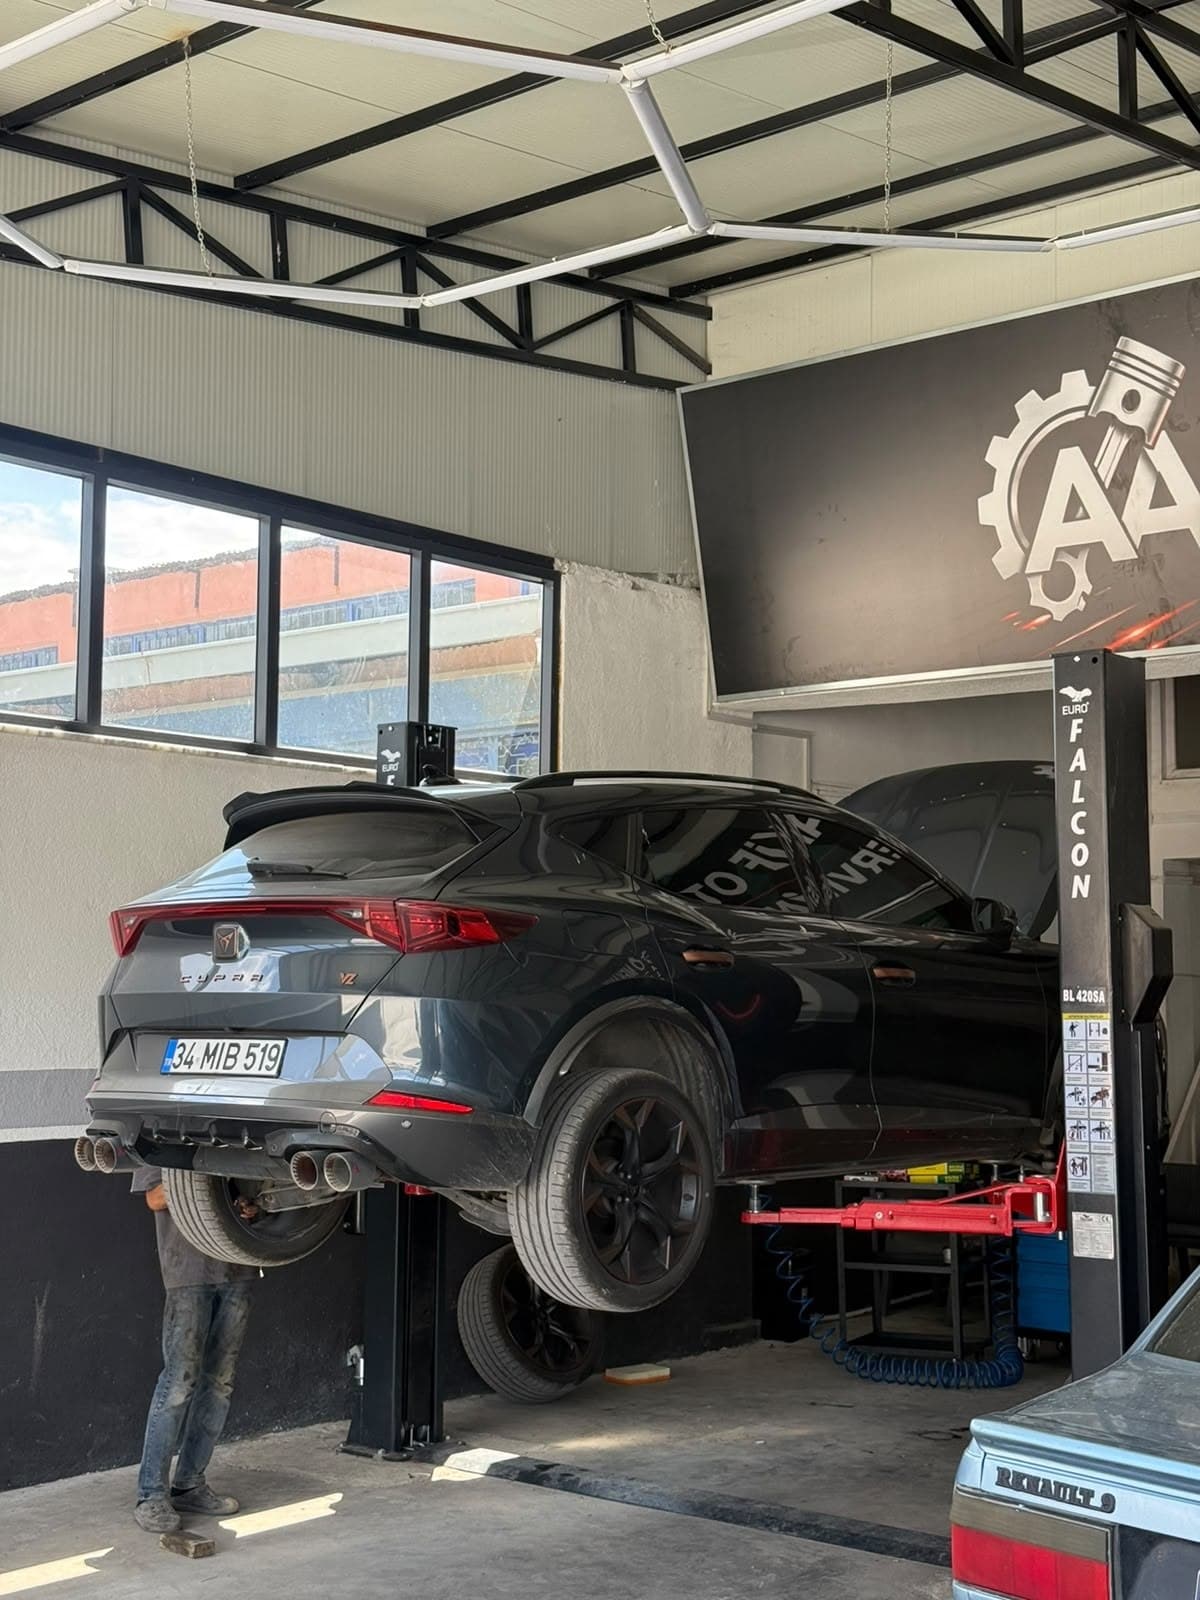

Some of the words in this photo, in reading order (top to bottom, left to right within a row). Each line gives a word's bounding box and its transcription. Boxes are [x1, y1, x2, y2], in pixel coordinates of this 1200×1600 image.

[1061, 703, 1089, 716] EURO
[1069, 718, 1091, 899] FALCON
[180, 973, 264, 984] CUPRA
[340, 972, 359, 985] VZ
[1063, 989, 1075, 1002] BL
[1076, 989, 1105, 1003] 420SA
[172, 1042, 197, 1070] 34
[200, 1041, 239, 1072] MIB
[243, 1042, 281, 1073] 519
[995, 1466, 1095, 1508] RENAULT
[1100, 1492, 1116, 1514] 9
